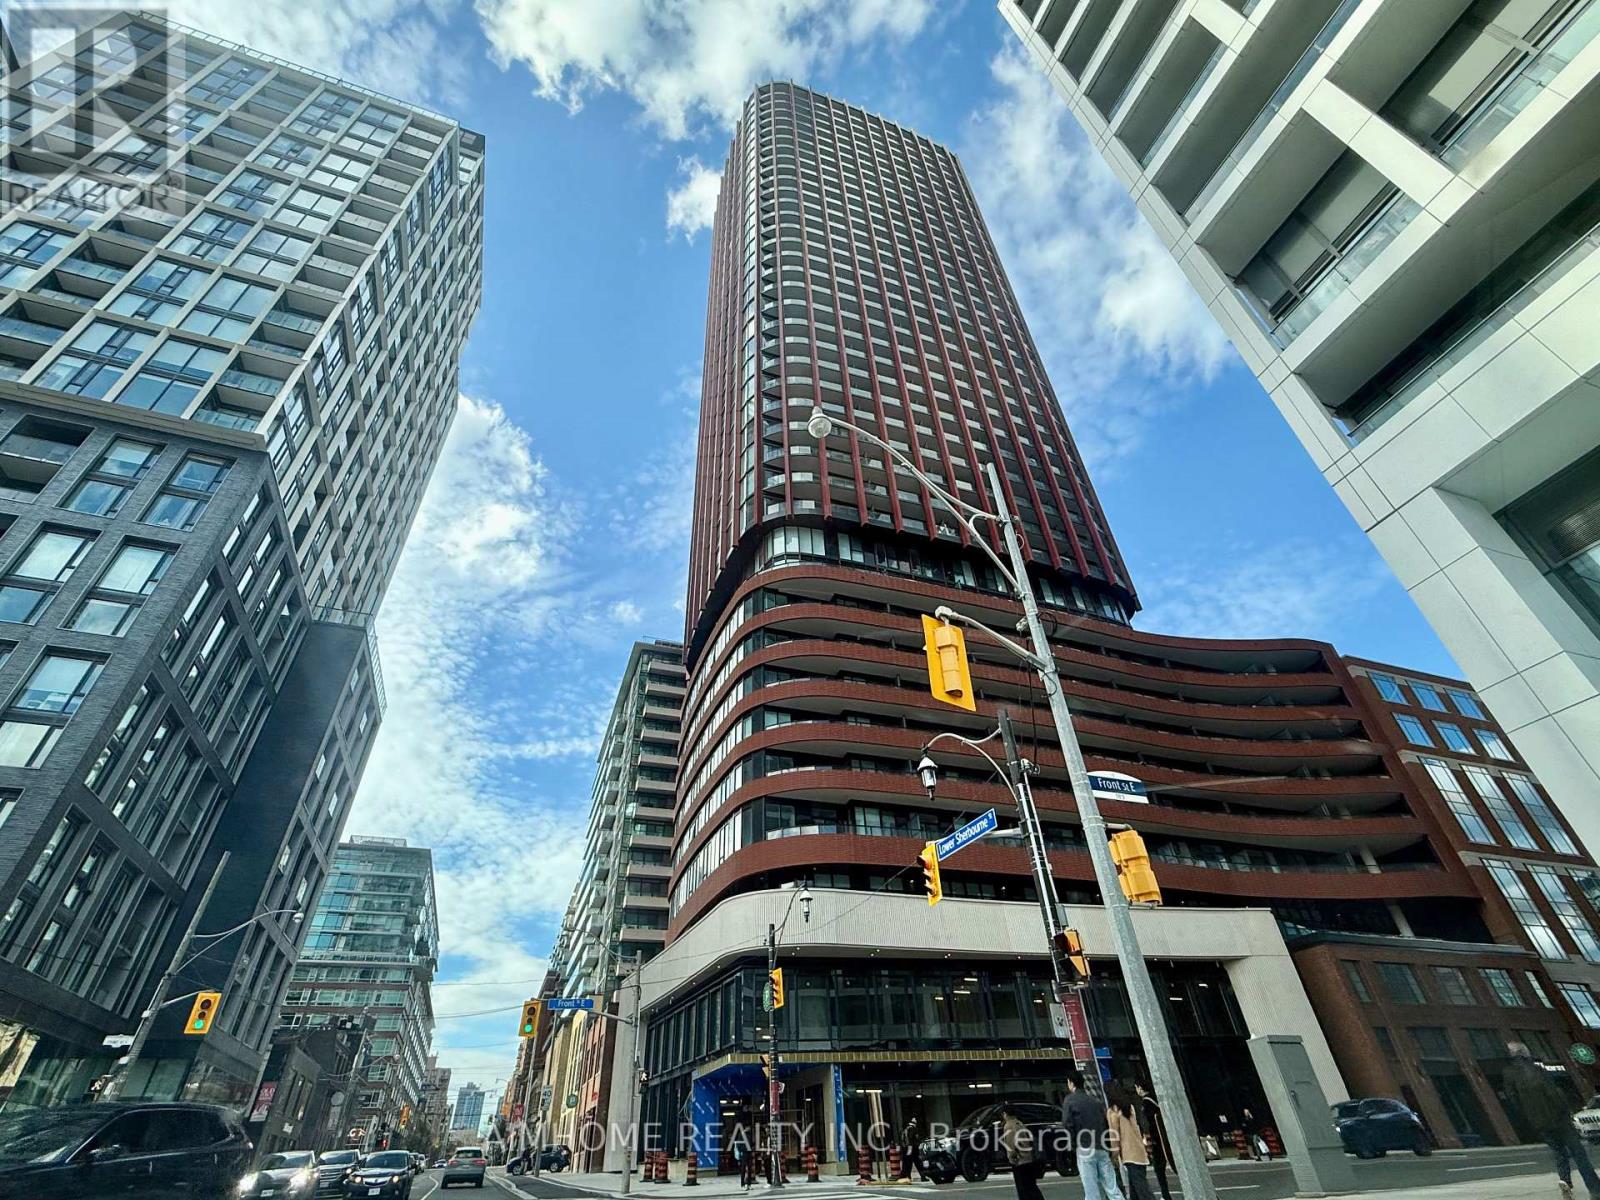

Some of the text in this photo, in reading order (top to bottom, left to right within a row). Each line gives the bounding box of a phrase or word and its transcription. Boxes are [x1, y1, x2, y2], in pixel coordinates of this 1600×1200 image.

[1097, 777, 1121, 791] Front
[1129, 781, 1136, 792] E
[938, 838, 955, 856] Lower
[955, 818, 988, 845] Sherbourne
[557, 999, 575, 1007] Front
